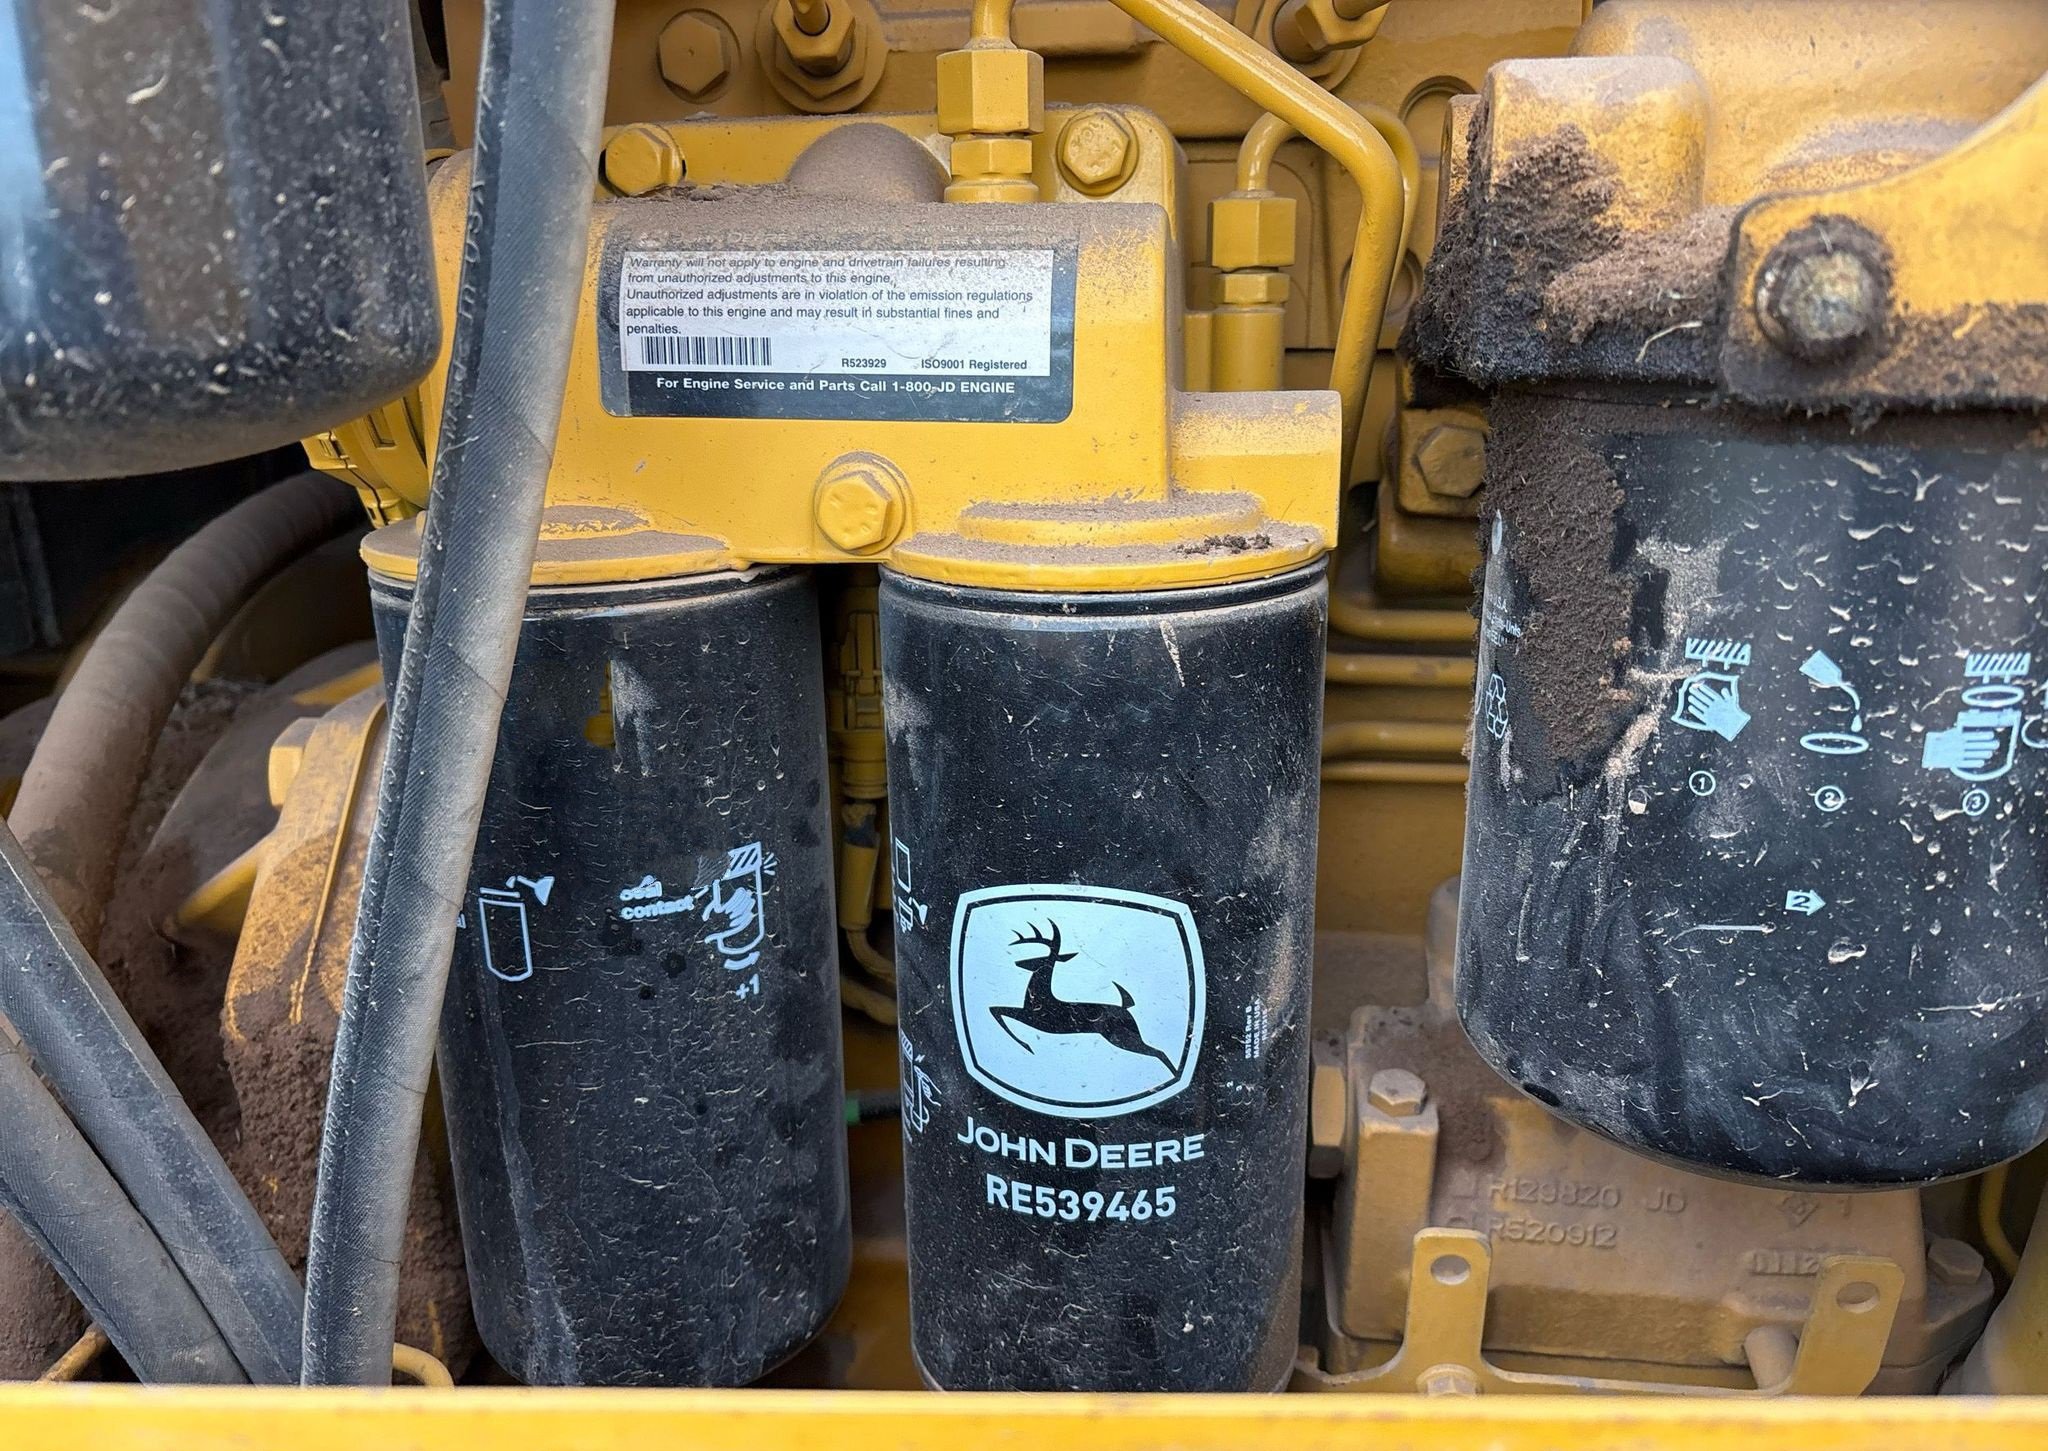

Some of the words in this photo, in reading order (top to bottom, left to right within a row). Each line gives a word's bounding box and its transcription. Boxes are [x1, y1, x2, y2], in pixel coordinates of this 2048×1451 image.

[630, 257, 683, 270] Warranty
[686, 257, 704, 268] will
[708, 257, 726, 268] not
[729, 257, 761, 270] apply
[764, 258, 776, 268] to
[779, 258, 819, 270] engine
[822, 258, 845, 268] and
[849, 257, 903, 268] drivetrain
[908, 257, 950, 268] failures
[955, 257, 1006, 270] resulting
[628, 272, 654, 283] from
[657, 272, 732, 284] unauthorized
[736, 272, 807, 286] adjustments
[811, 273, 822, 283] to
[825, 273, 847, 284] this
[627, 288, 704, 300] Unauthorized
[707, 288, 778, 302] adjustments
[782, 291, 801, 300] are
[805, 289, 815, 300] in
[819, 289, 868, 301] violation
[872, 289, 884, 300] of
[887, 289, 906, 301] the
[910, 289, 963, 301] emission
[967, 290, 1033, 303] regulations
[626, 306, 684, 318] applicable
[688, 307, 699, 317] to
[703, 306, 723, 318] this
[727, 307, 766, 320] engine
[770, 307, 793, 318] and
[797, 309, 821, 320] may
[826, 307, 858, 318] result
[862, 307, 872, 318] in
[876, 307, 940, 319] substantial
[944, 308, 973, 319] fines
[977, 308, 1000, 319] and
[626, 323, 681, 336] penalties.
[841, 358, 887, 368] R523929
[921, 359, 965, 369] ISO9001
[968, 360, 1027, 371] Registered
[656, 377, 679, 388] For
[683, 378, 730, 391] Engine
[734, 379, 785, 391] Service
[789, 379, 815, 391] and
[819, 380, 855, 391] Parts
[859, 380, 887, 392] Call
[960, 382, 1015, 393] ENGINE
[957, 1116, 1056, 1166] JOHN
[1065, 1133, 1205, 1169] DEERE
[986, 1173, 1177, 1222] RE539465
